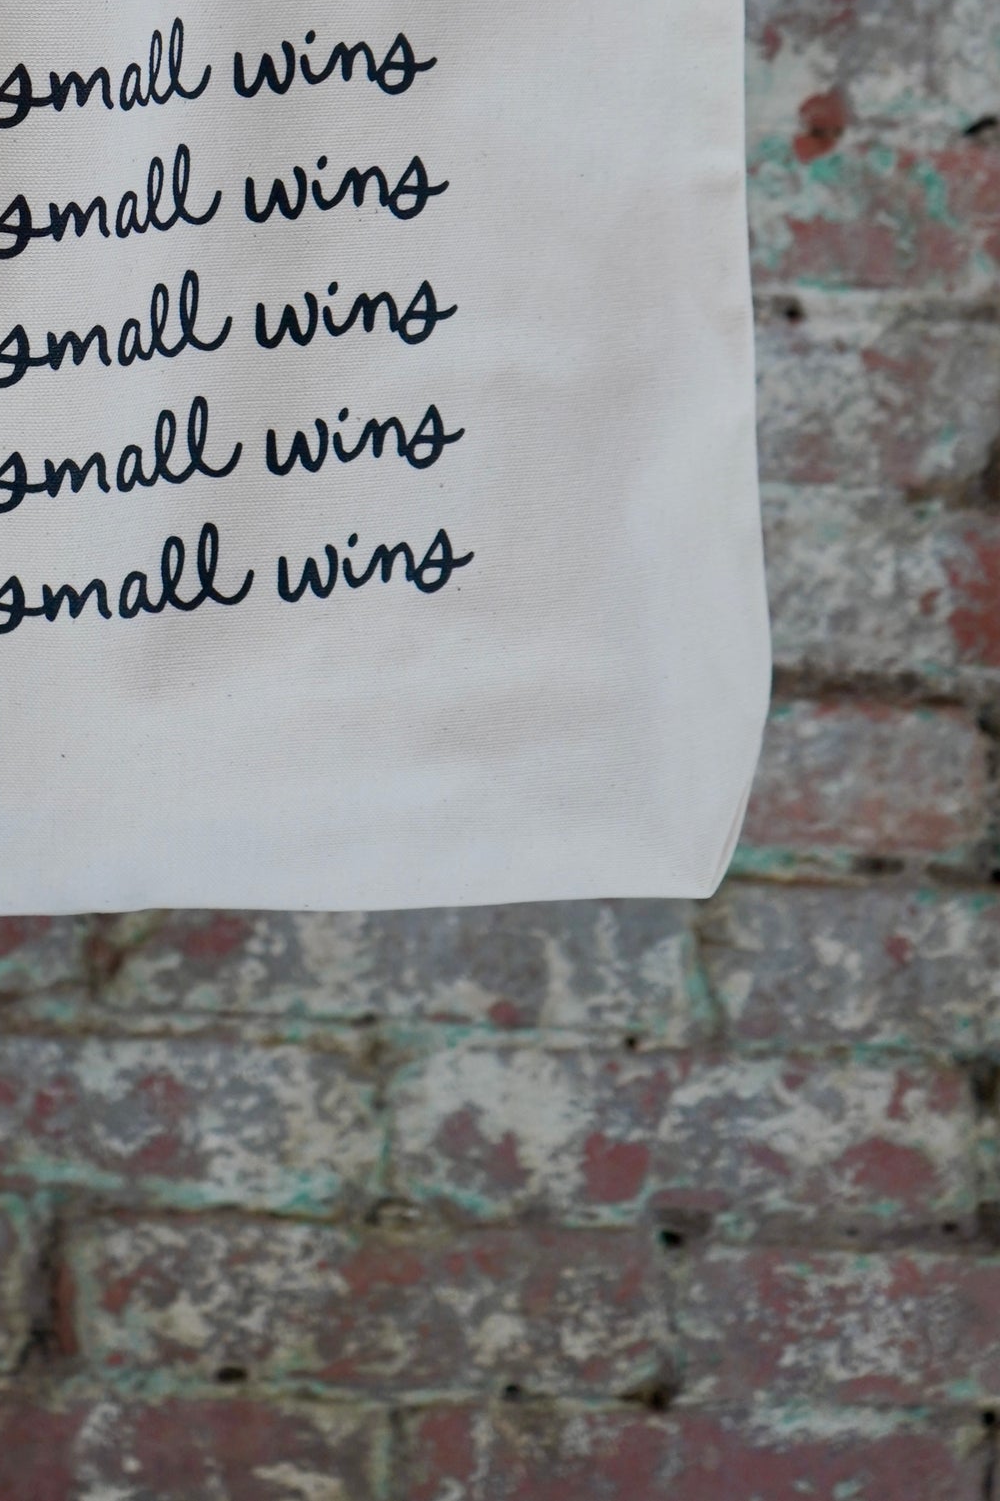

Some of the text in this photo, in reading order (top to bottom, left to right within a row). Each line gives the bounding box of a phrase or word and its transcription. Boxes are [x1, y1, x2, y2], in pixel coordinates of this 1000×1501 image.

[233, 29, 438, 99] wins
[244, 155, 450, 224] wins
[254, 279, 458, 350] wins
[265, 404, 466, 477] wins
[277, 528, 475, 603] wins
